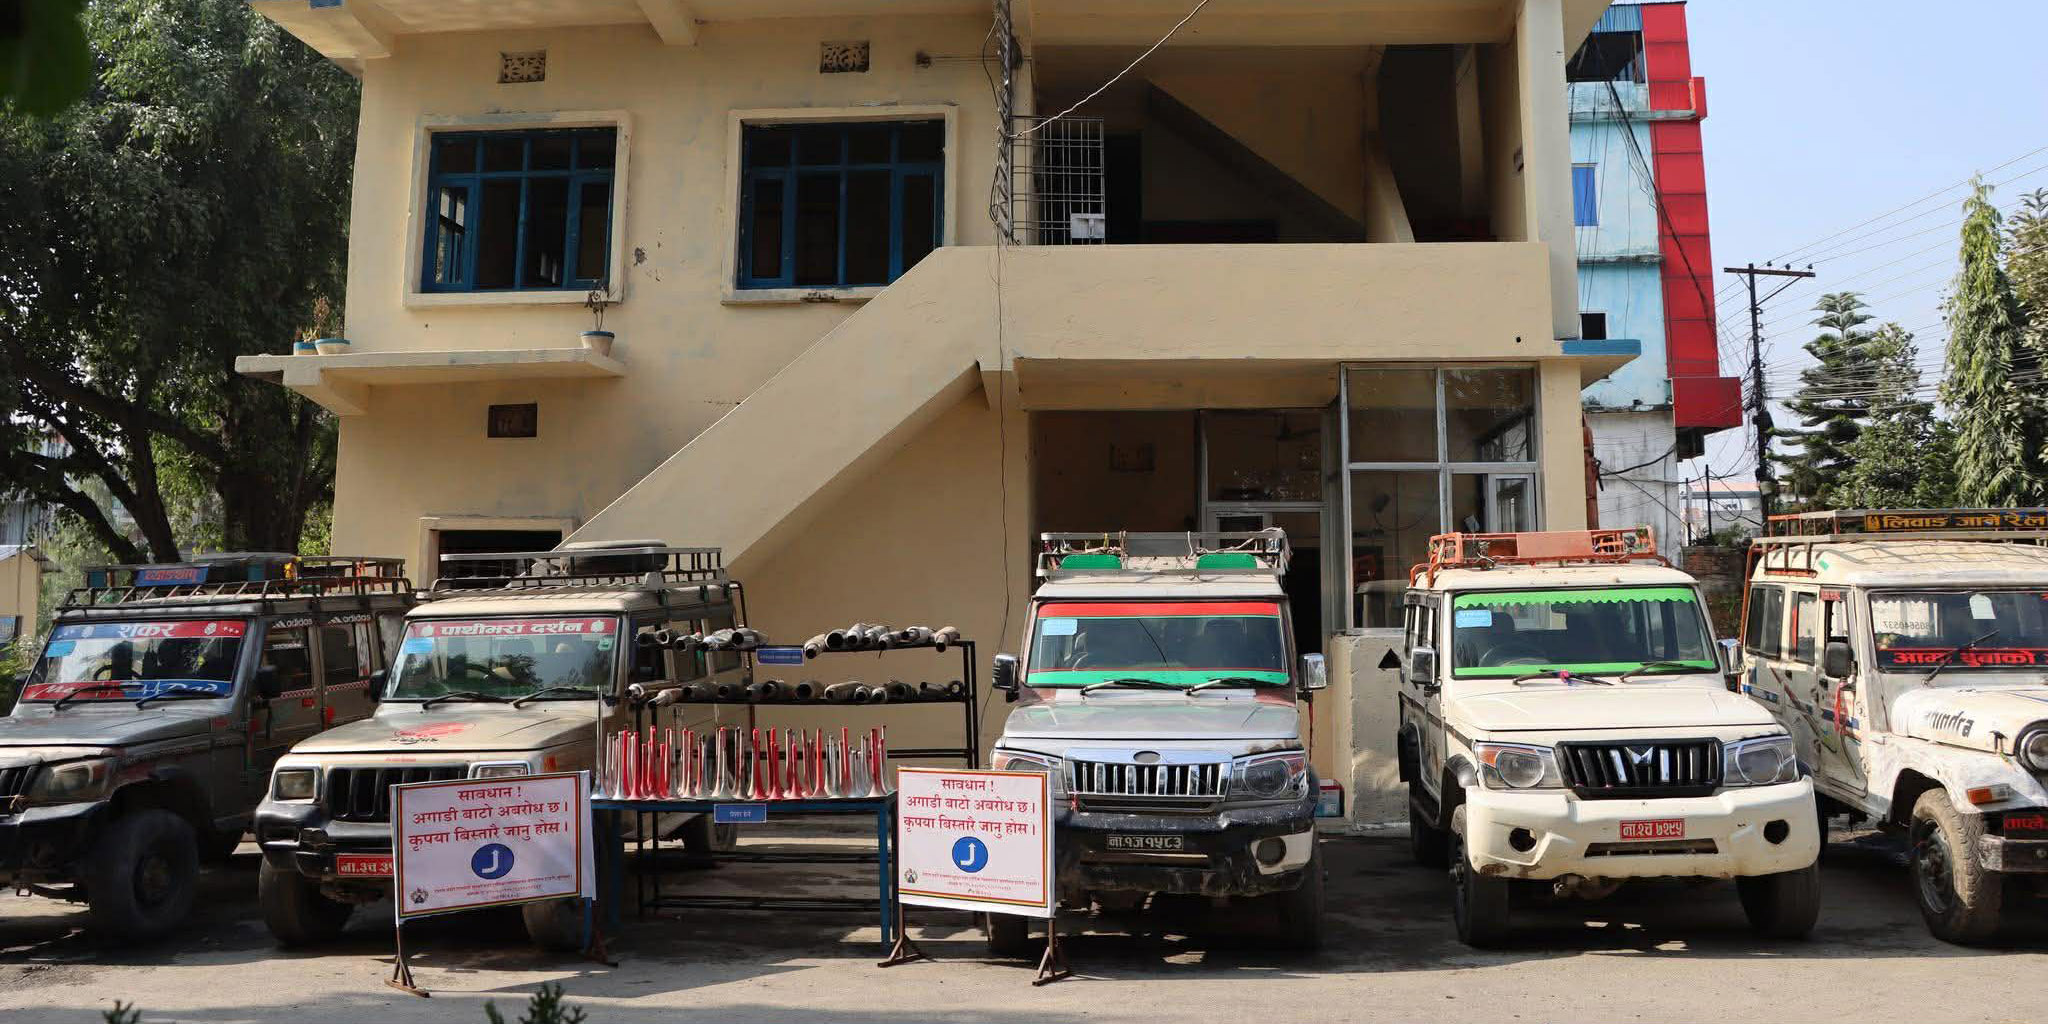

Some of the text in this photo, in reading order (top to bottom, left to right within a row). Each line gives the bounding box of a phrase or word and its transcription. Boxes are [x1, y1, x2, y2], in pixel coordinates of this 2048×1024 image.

[286, 618, 313, 628] adidas
[342, 614, 371, 623] adidas
[941, 778, 986, 791] सावधान
[457, 785, 512, 802] सावधान
[906, 793, 941, 809] अगाडी
[945, 794, 970, 810] बाटो
[413, 806, 458, 824] अगाडी
[462, 803, 493, 820] बाटो
[903, 815, 935, 833] कृपया
[979, 819, 1002, 838] जानु
[1005, 818, 1028, 835] होस
[408, 831, 449, 852] कृपया
[503, 824, 530, 841] जानु
[535, 819, 560, 835] होस
[380, 861, 393, 873] ३
